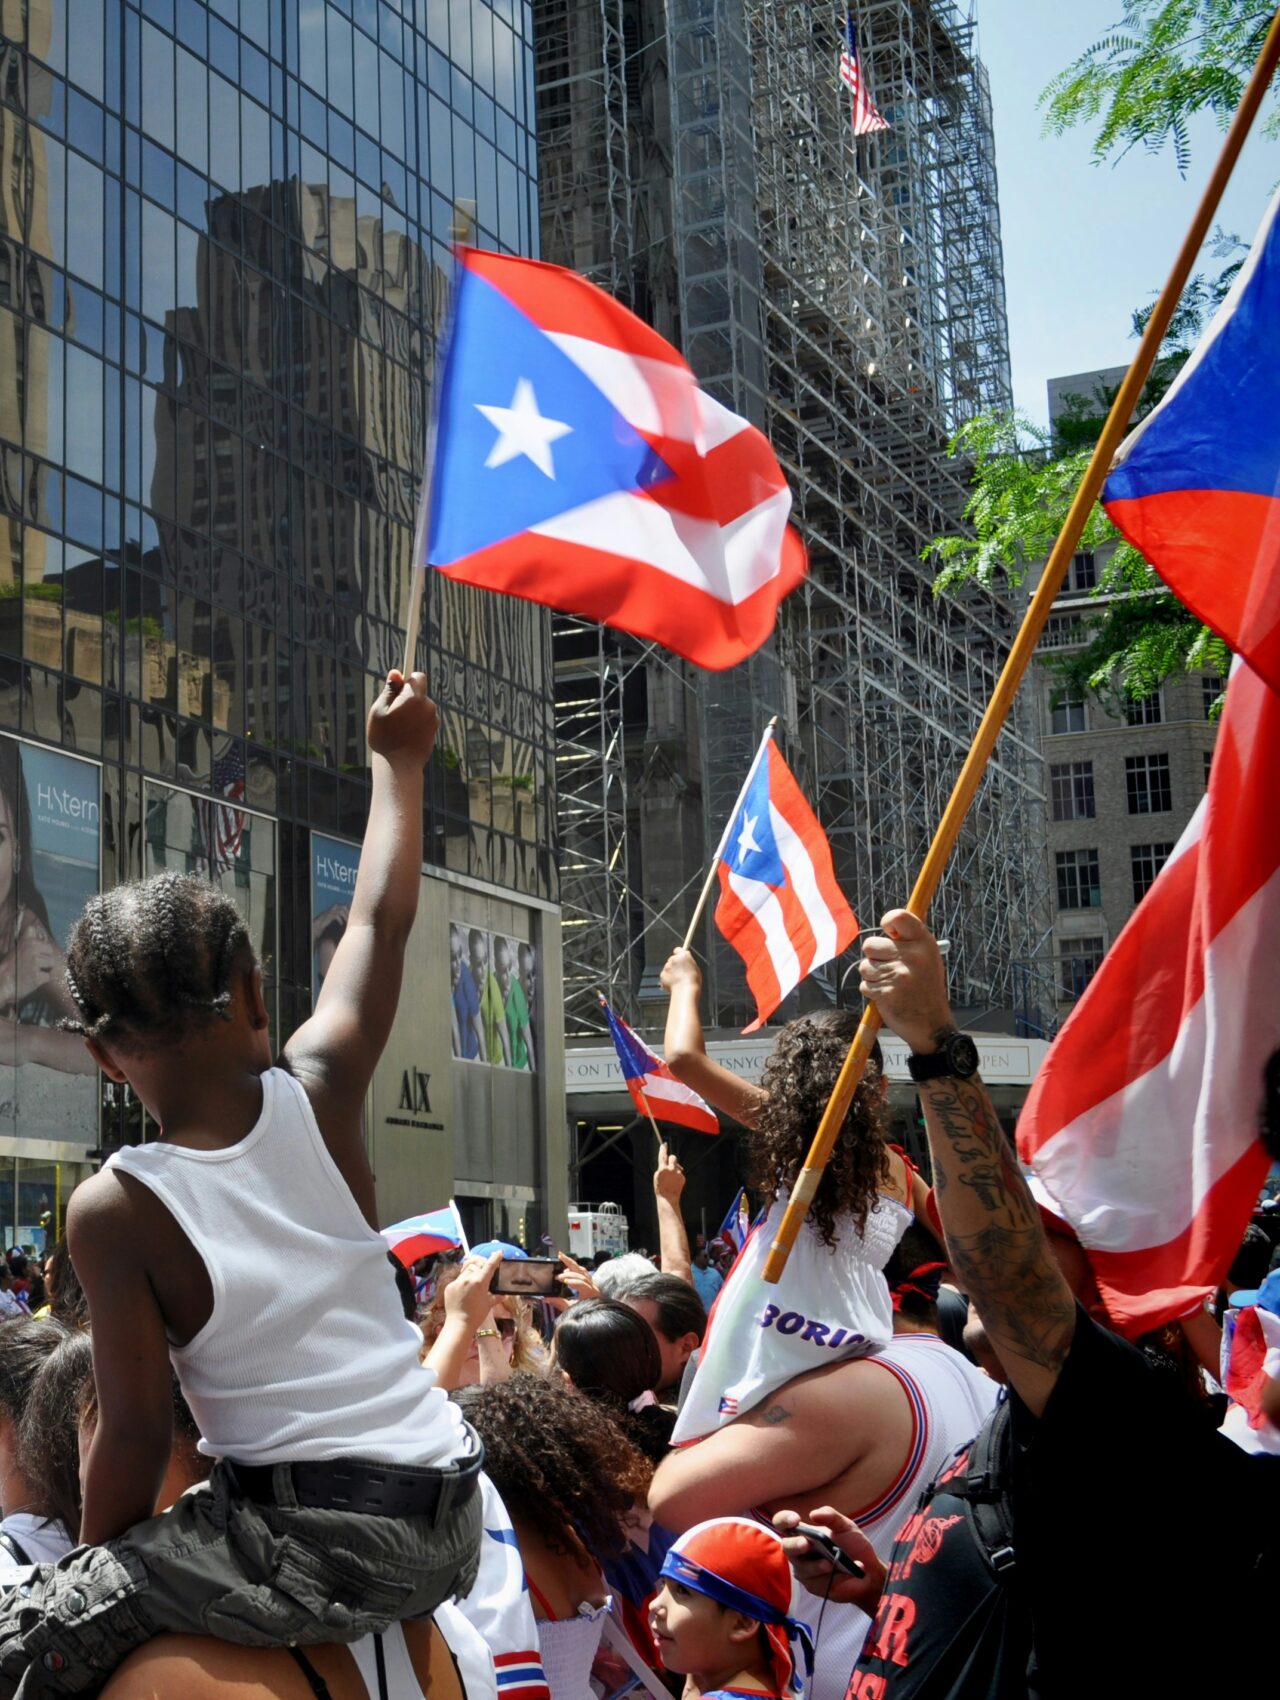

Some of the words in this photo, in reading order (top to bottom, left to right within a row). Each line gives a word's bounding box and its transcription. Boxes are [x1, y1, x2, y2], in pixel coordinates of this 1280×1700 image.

[578, 1063, 599, 1077] ON
[980, 1053, 1009, 1069] PEN
[759, 1303, 875, 1350] BORI
